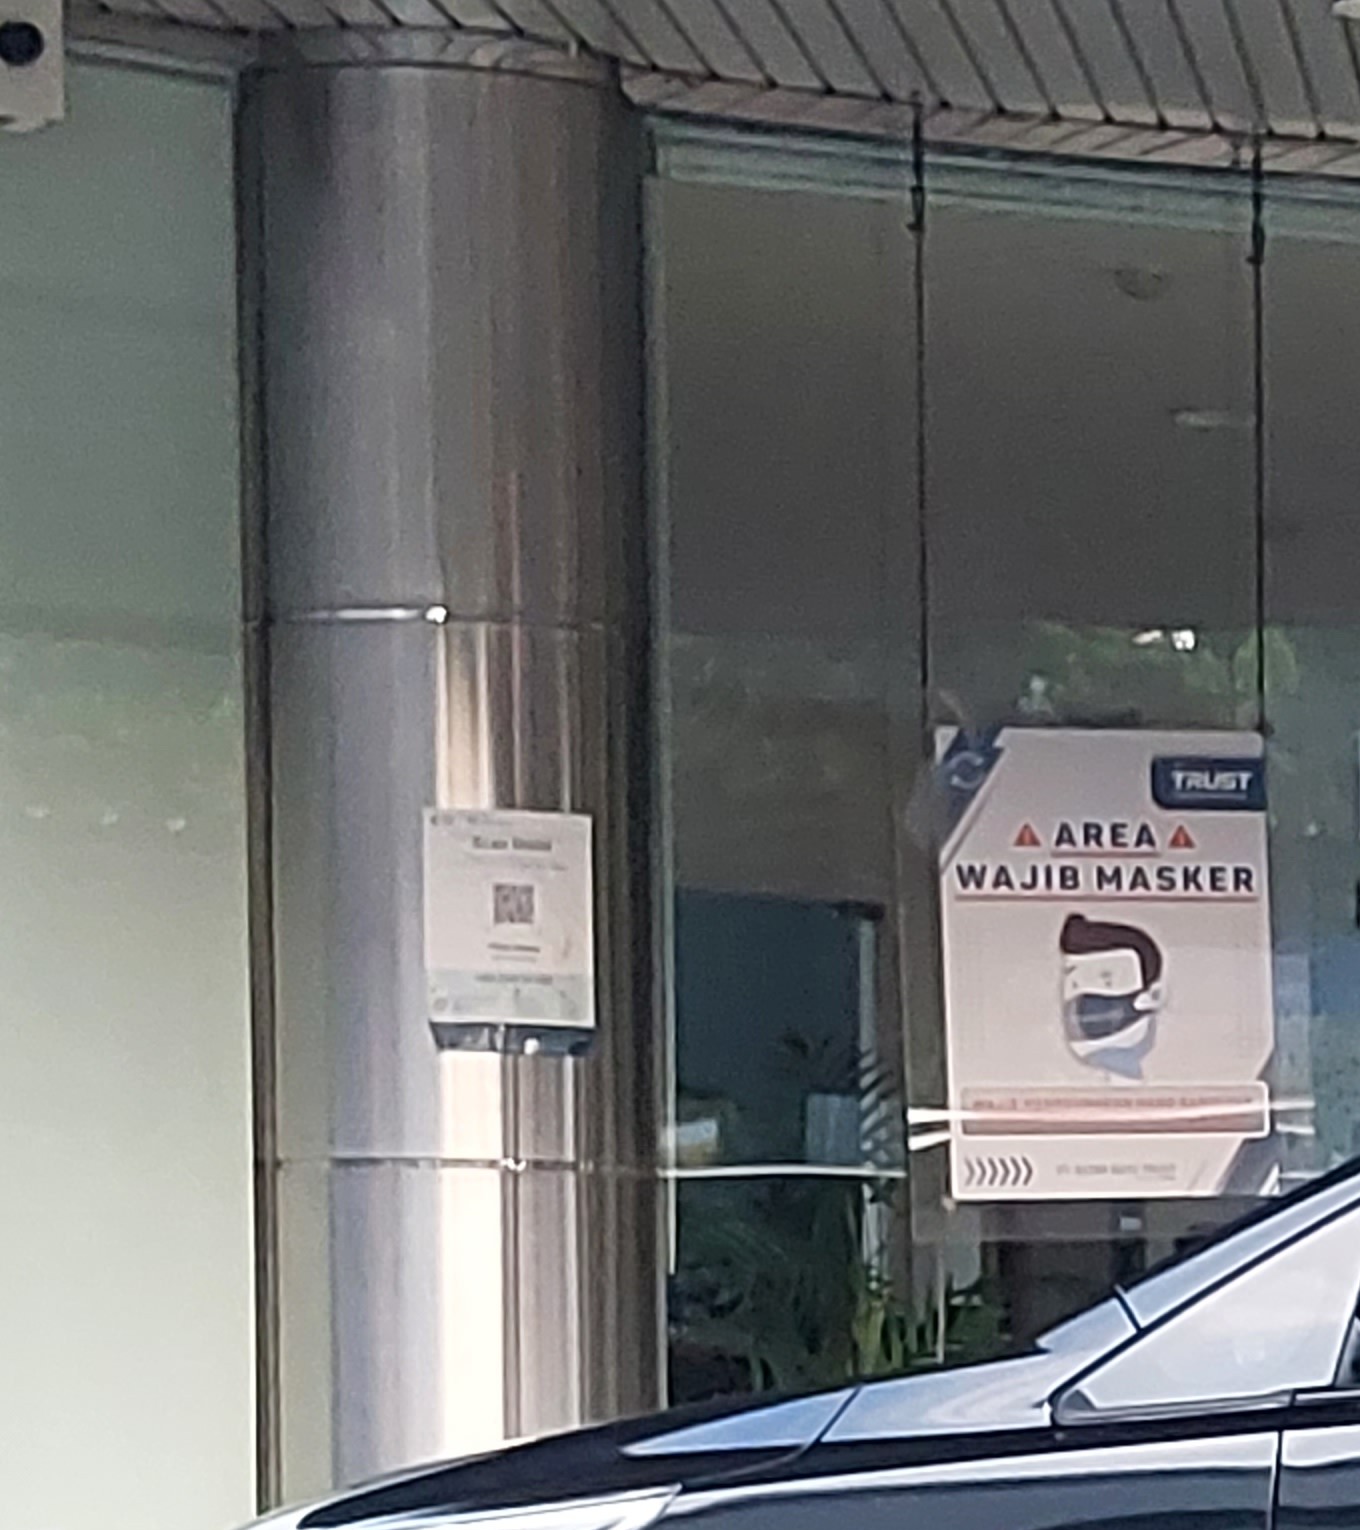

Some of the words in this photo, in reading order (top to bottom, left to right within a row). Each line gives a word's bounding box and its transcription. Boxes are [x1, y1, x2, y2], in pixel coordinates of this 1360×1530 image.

[1171, 770, 1253, 791] TRUST
[1054, 822, 1156, 848] AREA
[956, 864, 1080, 890] WAJIB
[1096, 865, 1254, 892] MASKER
